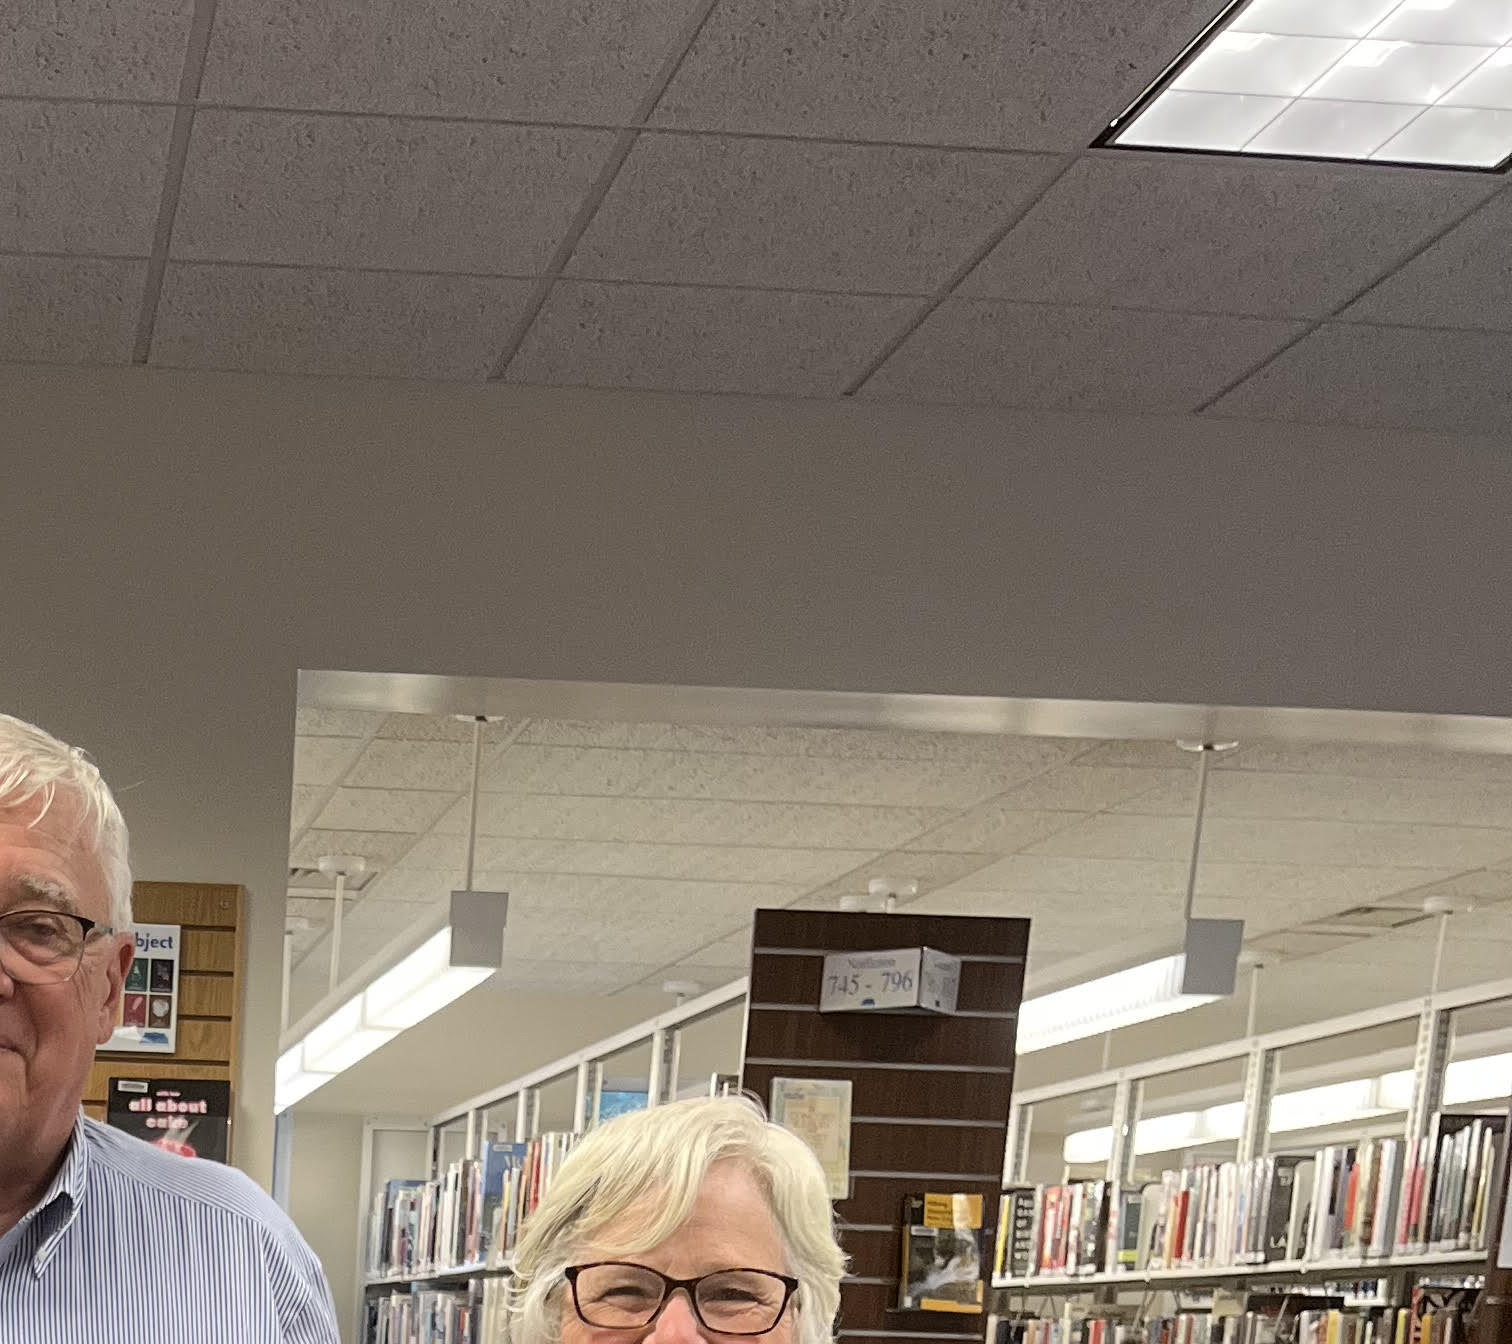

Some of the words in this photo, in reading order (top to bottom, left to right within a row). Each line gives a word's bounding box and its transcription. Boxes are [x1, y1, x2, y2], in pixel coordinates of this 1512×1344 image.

[135, 932, 174, 952] bject
[827, 974, 859, 995] 745
[882, 970, 913, 992] 796
[129, 1098, 152, 1112] all
[155, 1099, 207, 1113] about
